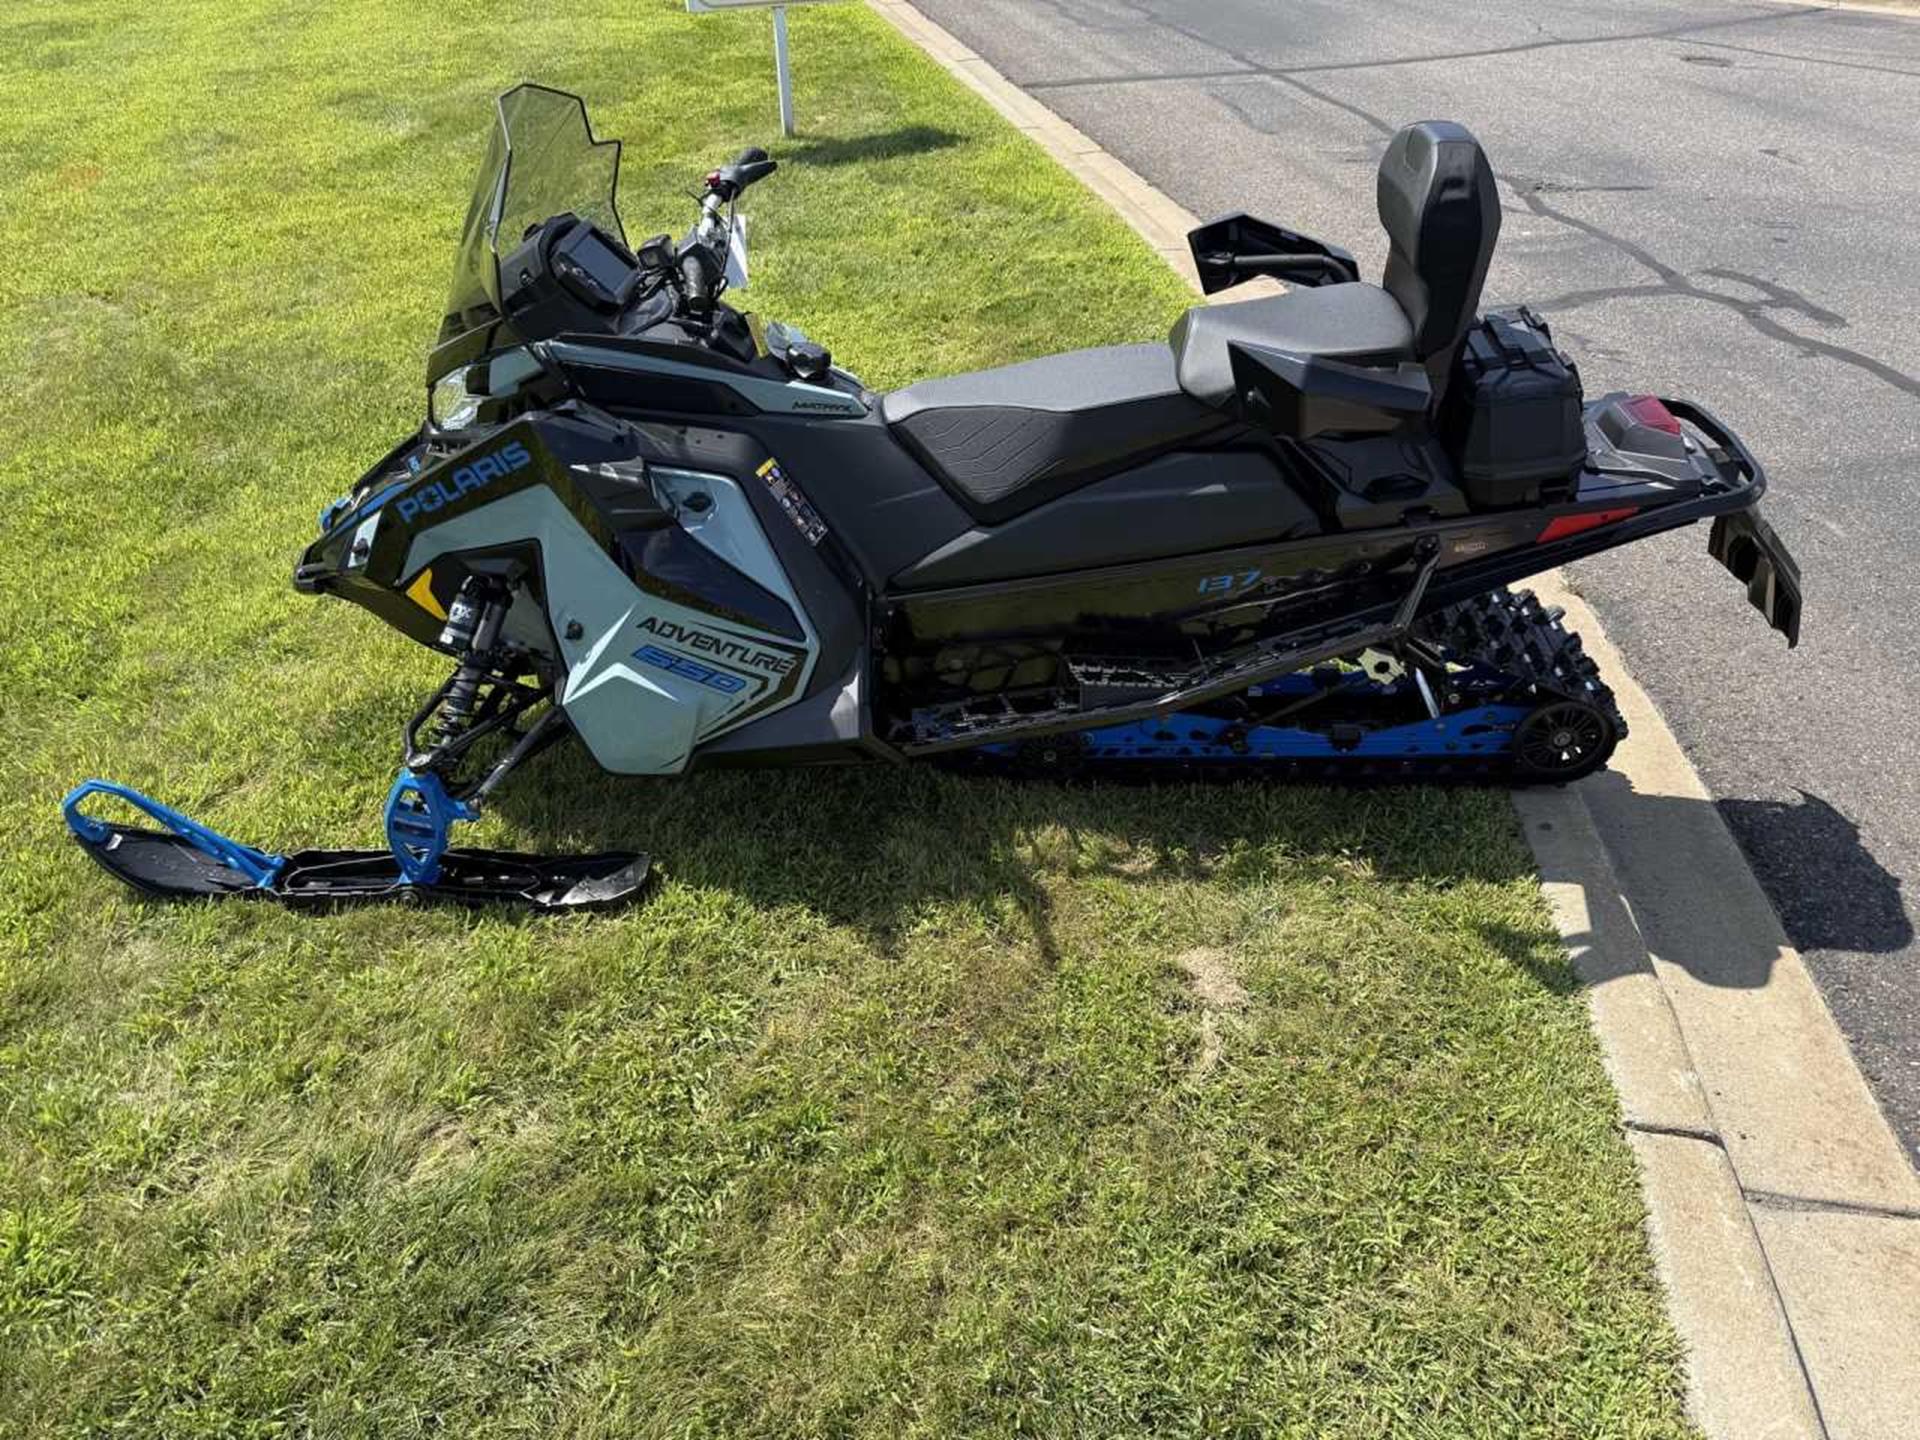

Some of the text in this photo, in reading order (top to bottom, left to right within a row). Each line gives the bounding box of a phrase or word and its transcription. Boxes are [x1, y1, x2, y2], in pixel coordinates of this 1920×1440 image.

[395, 441, 531, 523] POLARIS
[1199, 570, 1261, 594] 137
[631, 644, 746, 695] 650
[636, 616, 796, 674] ADVENTURE
